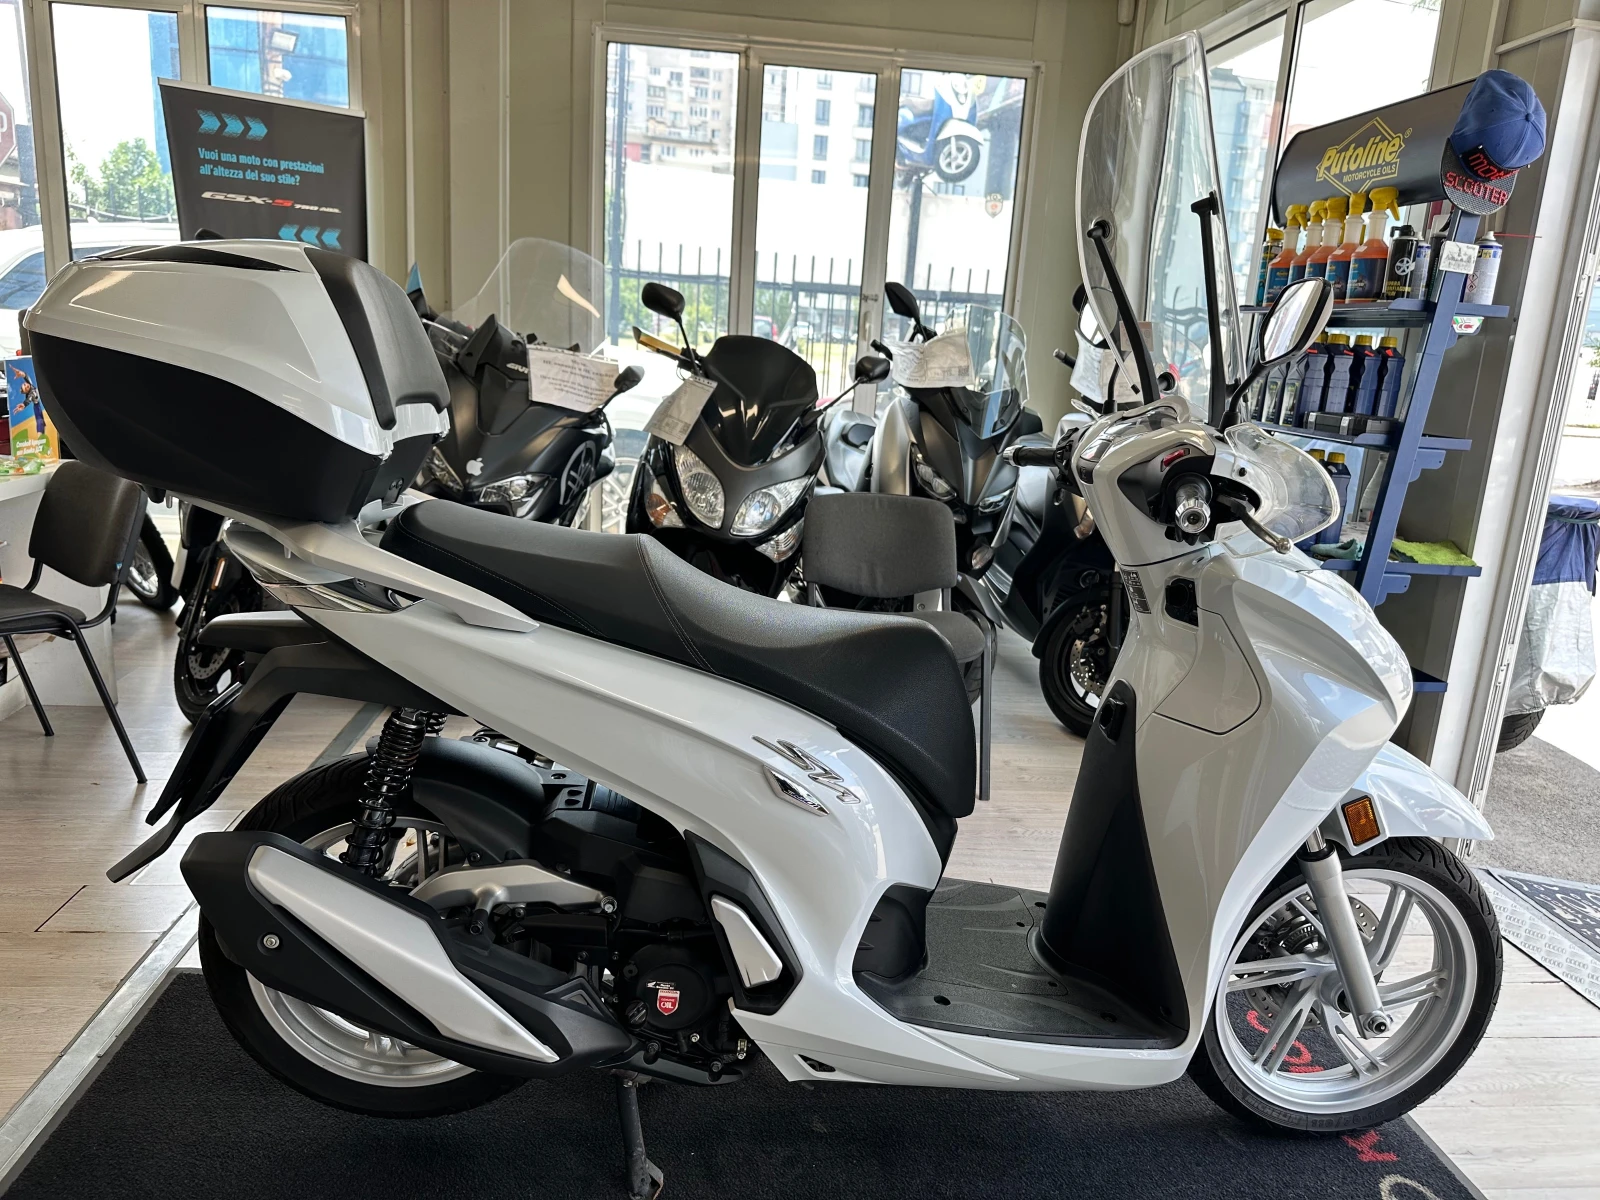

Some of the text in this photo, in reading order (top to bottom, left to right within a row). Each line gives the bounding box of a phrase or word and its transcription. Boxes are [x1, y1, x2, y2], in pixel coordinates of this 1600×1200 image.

[198, 147, 325, 174] Vuoi una moto con prestazioni
[1317, 134, 1402, 178] Putoline
[199, 163, 301, 185] all'altezza del suo stile?
[1343, 164, 1396, 183] MOTORCYCLE OILS
[201, 191, 295, 207] GSX-S
[1443, 171, 1509, 206] SCOOTER
